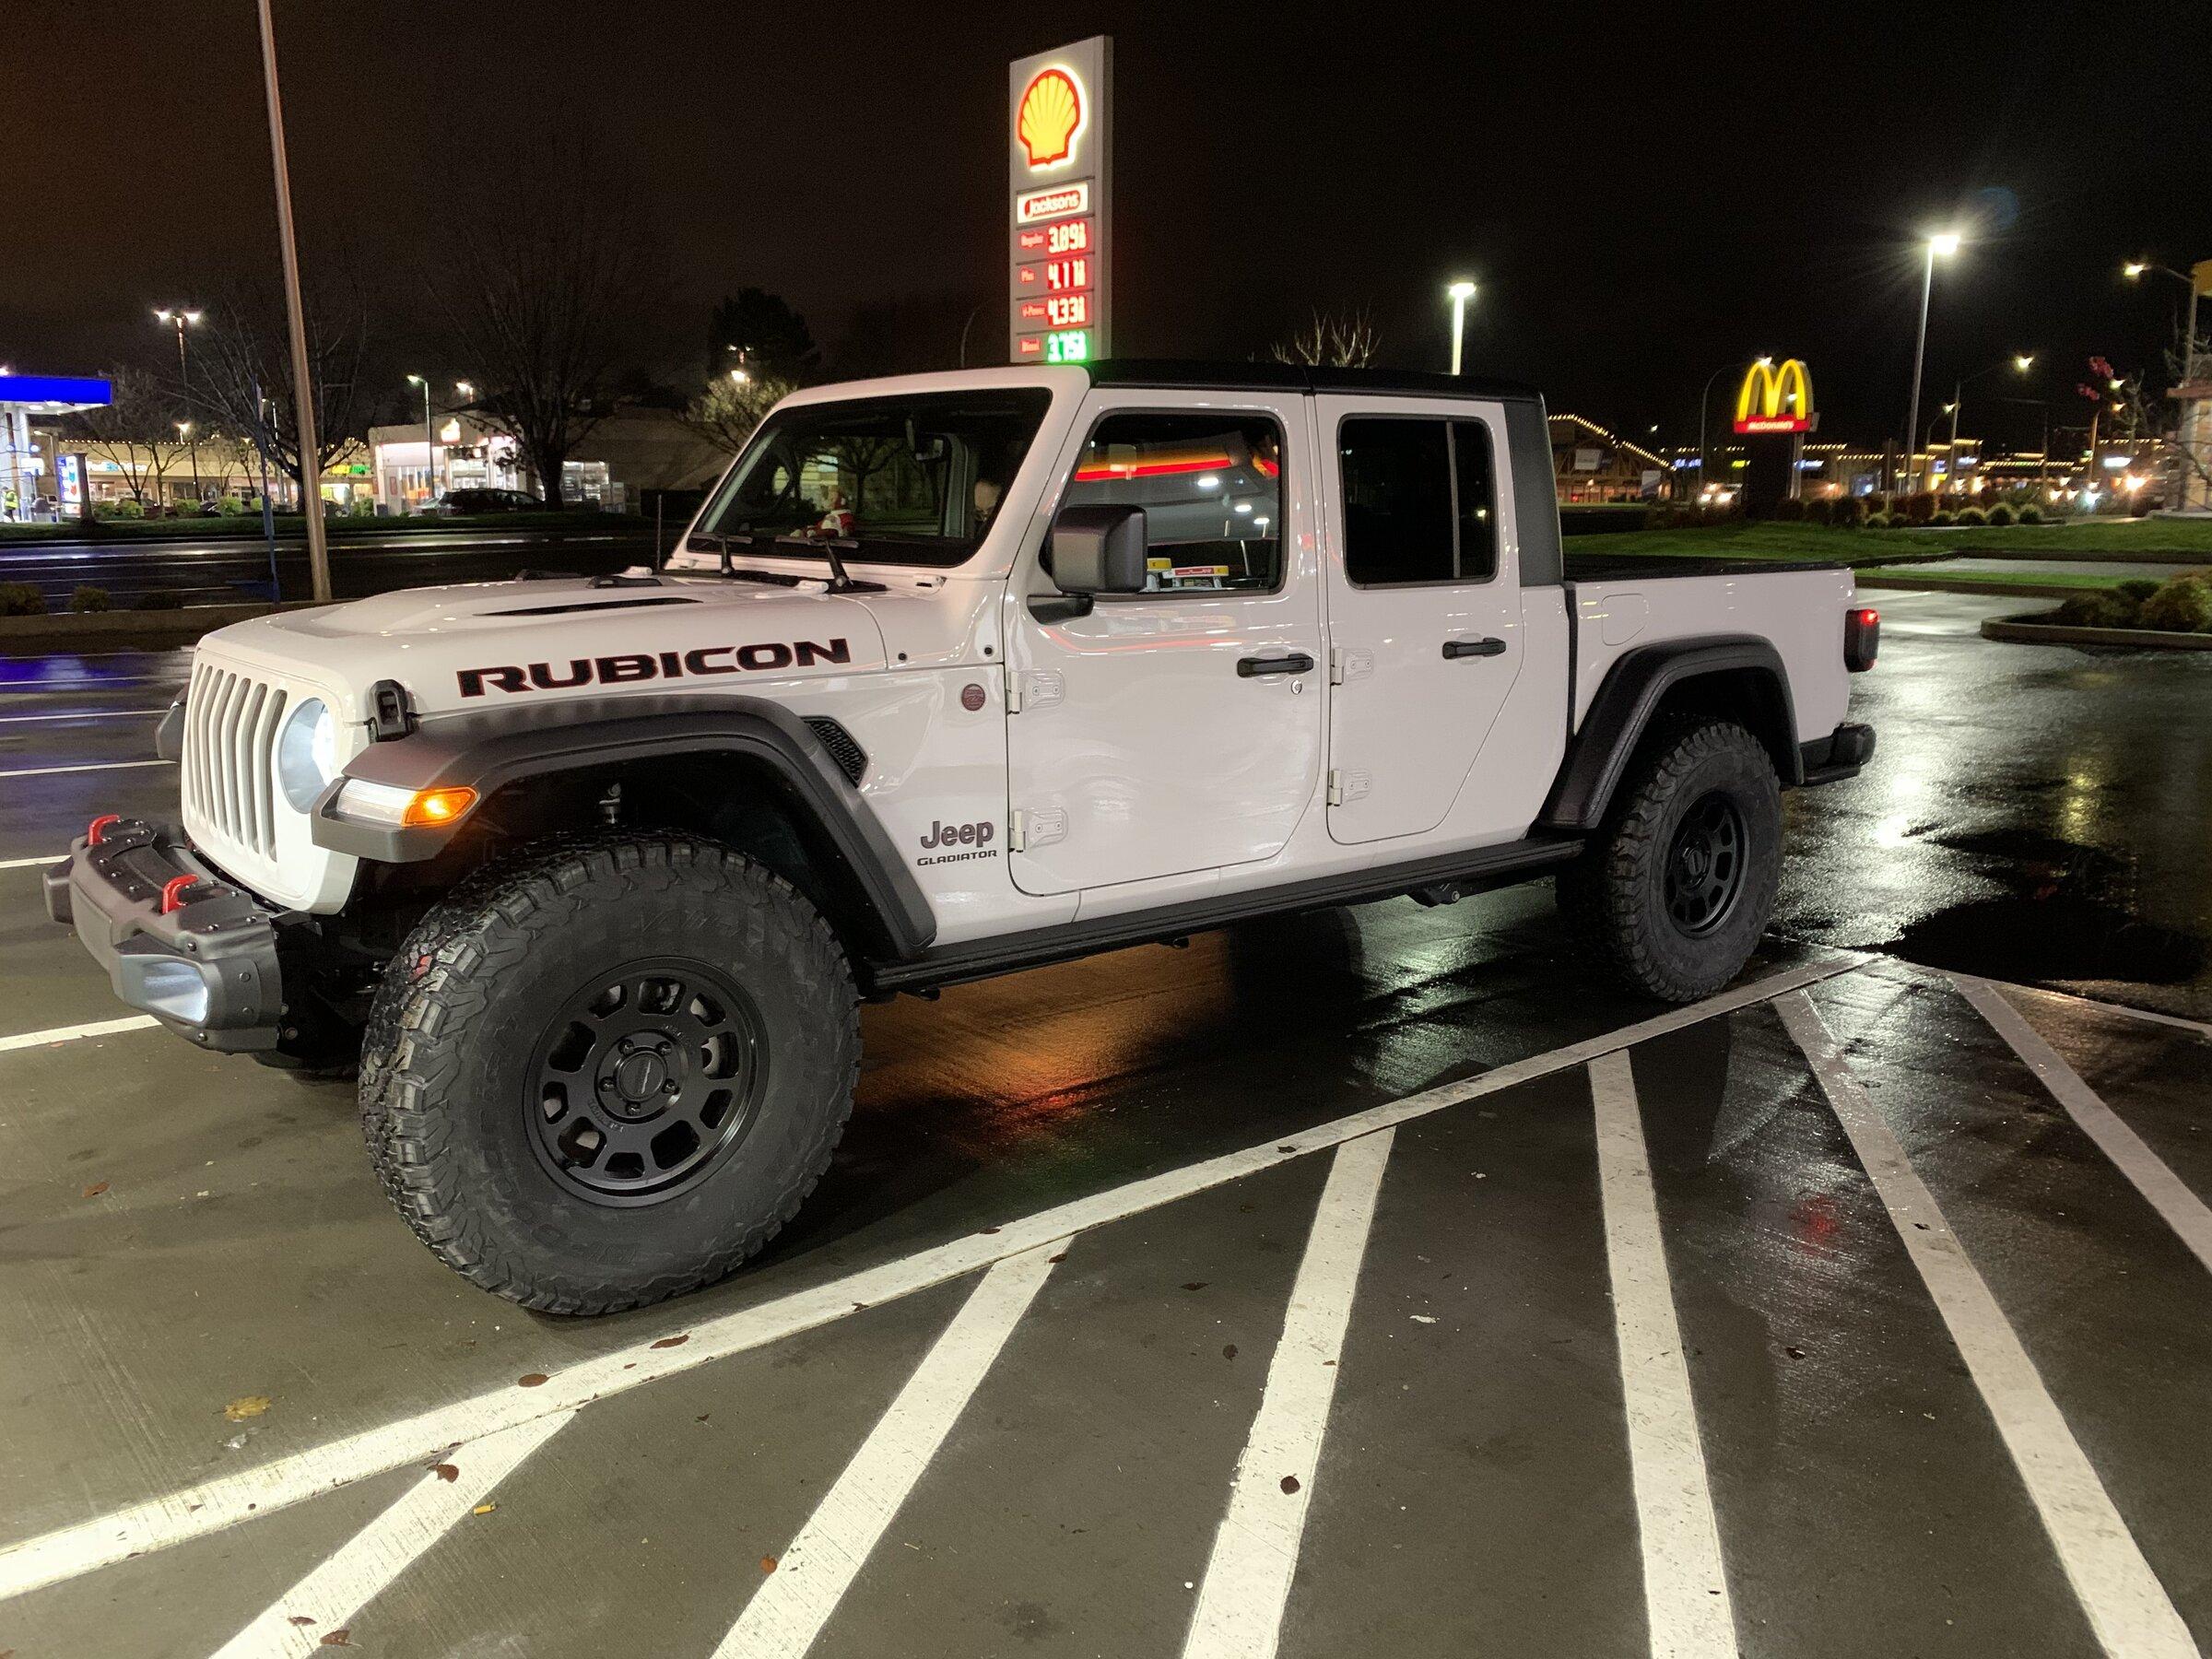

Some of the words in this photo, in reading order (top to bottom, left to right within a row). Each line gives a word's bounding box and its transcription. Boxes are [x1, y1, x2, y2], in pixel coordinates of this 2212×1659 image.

[456, 638, 851, 698] RUBICON
[920, 820, 994, 849] Jeep
[916, 850, 998, 866] GLADIATOR
